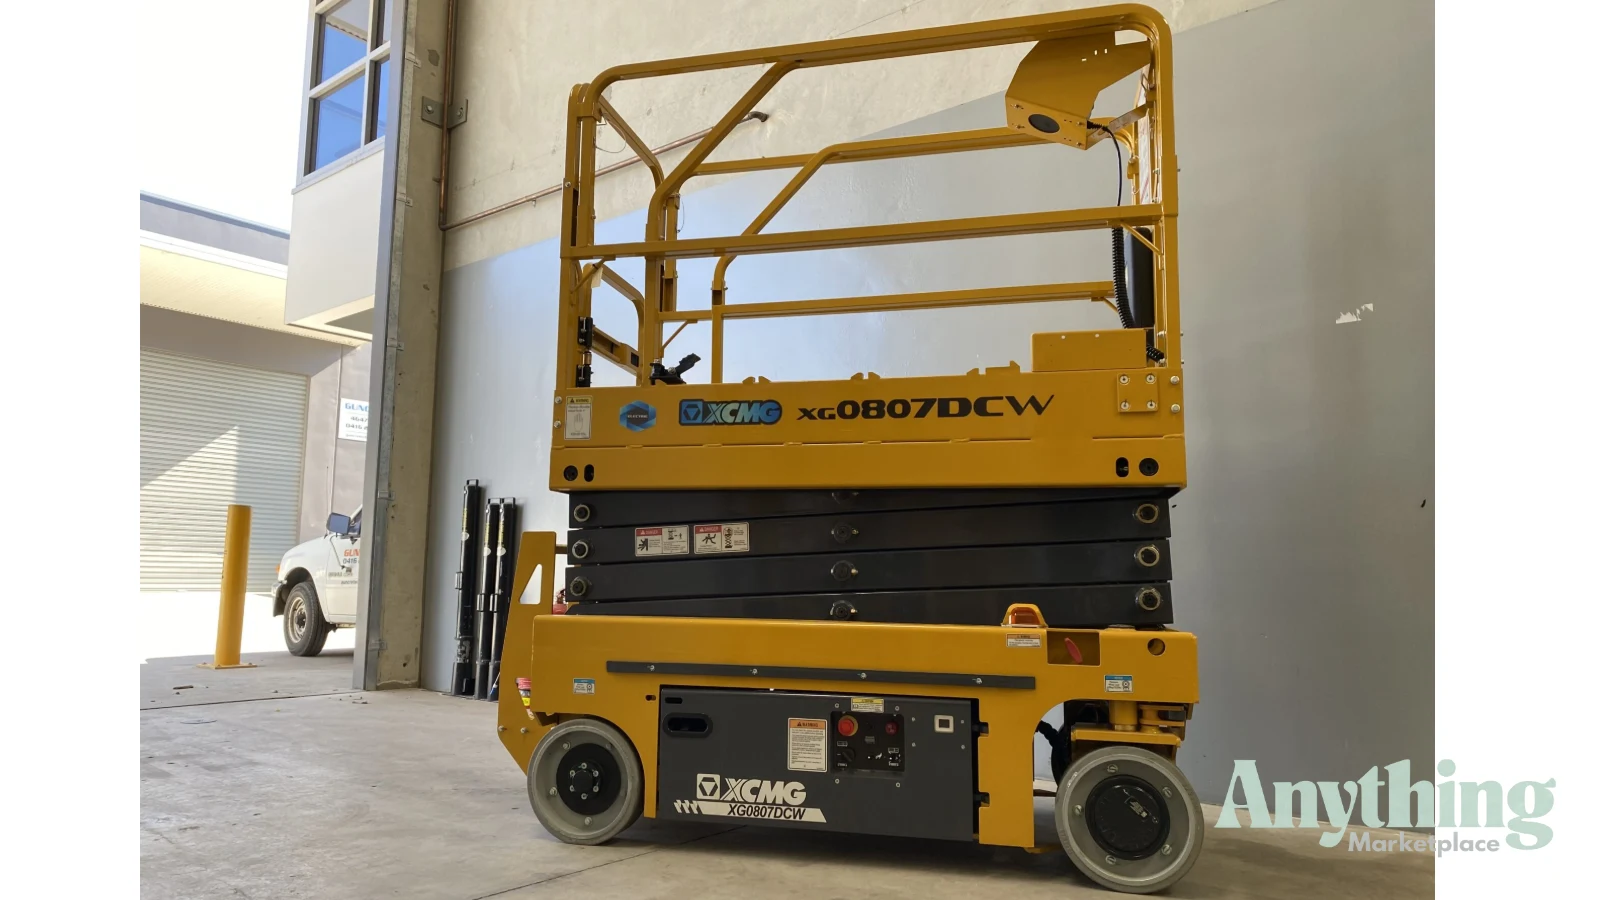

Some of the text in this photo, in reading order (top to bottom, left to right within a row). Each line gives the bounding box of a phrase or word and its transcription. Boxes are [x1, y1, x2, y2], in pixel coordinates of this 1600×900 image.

[703, 401, 782, 425] XCMG
[796, 395, 1055, 421] XG0807DCW
[719, 777, 807, 805] XCMG
[728, 804, 806, 820] XG0807DCW
